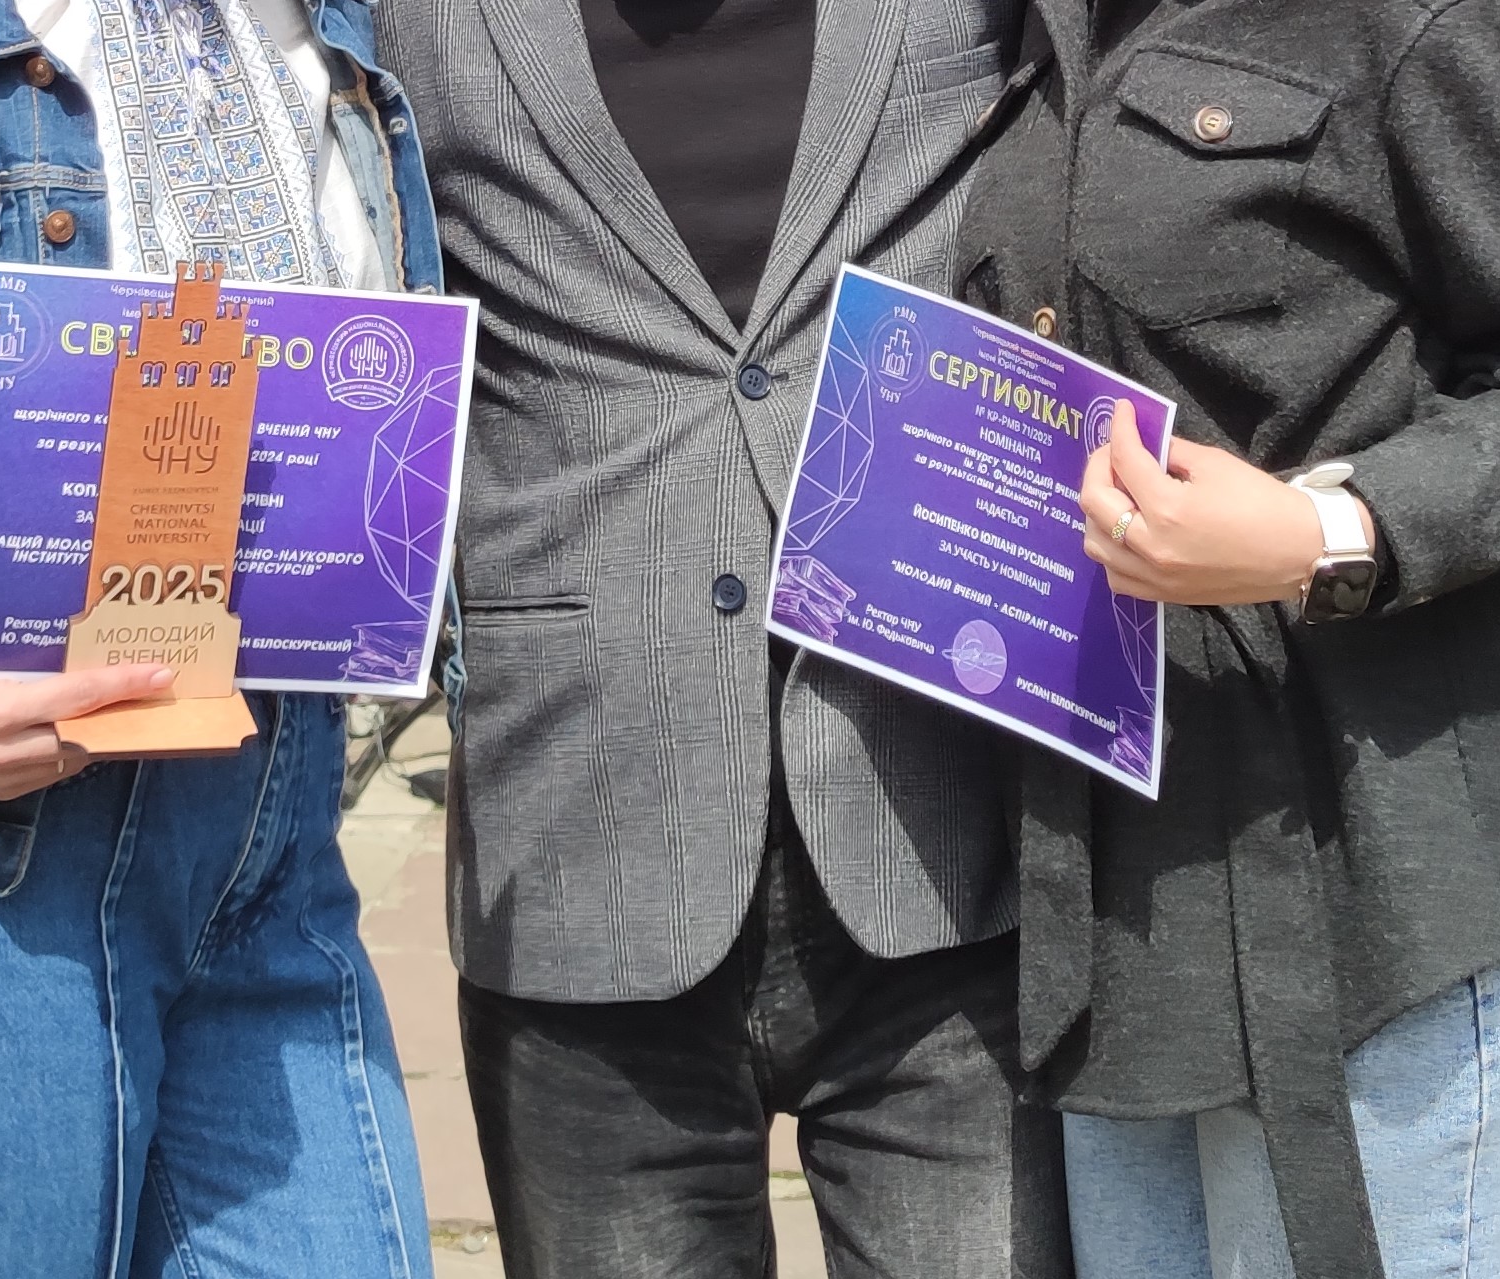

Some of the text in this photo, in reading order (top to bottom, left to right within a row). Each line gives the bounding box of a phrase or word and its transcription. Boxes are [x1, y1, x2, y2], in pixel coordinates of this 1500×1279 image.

[894, 306, 918, 324] РМВ
[880, 386, 902, 404] ЧНУ
[929, 350, 1083, 440] СЕРТИФІКАТ
[14, 408, 91, 424] щорічного
[256, 422, 311, 438] ВЧЕНИЙ
[314, 426, 342, 440] ЧНУ
[1021, 423, 1053, 447] 71/2025
[35, 438, 56, 452] за
[250, 450, 285, 463] 2024
[286, 453, 321, 468] році
[902, 423, 953, 448] щорічного
[953, 442, 1000, 467] конкурсу
[979, 426, 1043, 465] НОМІНАНТА
[142, 445, 219, 474] ЧНУ
[75, 509, 95, 524] ЗА
[130, 503, 215, 515] CHERNIVTSI
[976, 498, 1029, 530] НАДАЄТЬСЯ
[1050, 506, 1071, 525] 2024
[134, 518, 208, 529] NATIONAL
[45, 536, 93, 552] МОЛО
[127, 532, 211, 544] UNIVERSITY
[913, 503, 1075, 584] ЙОСИПЕНКО ЮЛІАНІ РУСЛАНІВНІ
[12, 550, 90, 567] ІНСТИТУТУ
[939, 539, 1052, 596] ЗА УЧАСТЬ У НОМІНАЦІЇ
[101, 564, 227, 605] 2025
[865, 603, 923, 633] Ректор ЧНУ
[953, 582, 993, 608] ВЧЕНИЙ
[1000, 602, 1050, 633] АСПІРАНТ
[4, 616, 51, 632] Ректор
[95, 622, 216, 644] МОЛОДИЙ
[252, 637, 352, 653] БІЛОСКУРСЬКИЙ
[876, 623, 936, 655] Федьковича
[106, 644, 199, 666] ВЧЕНИЙ
[1016, 675, 1117, 734] РУСЛАН БІЛОСКУРСЬКИЙ
